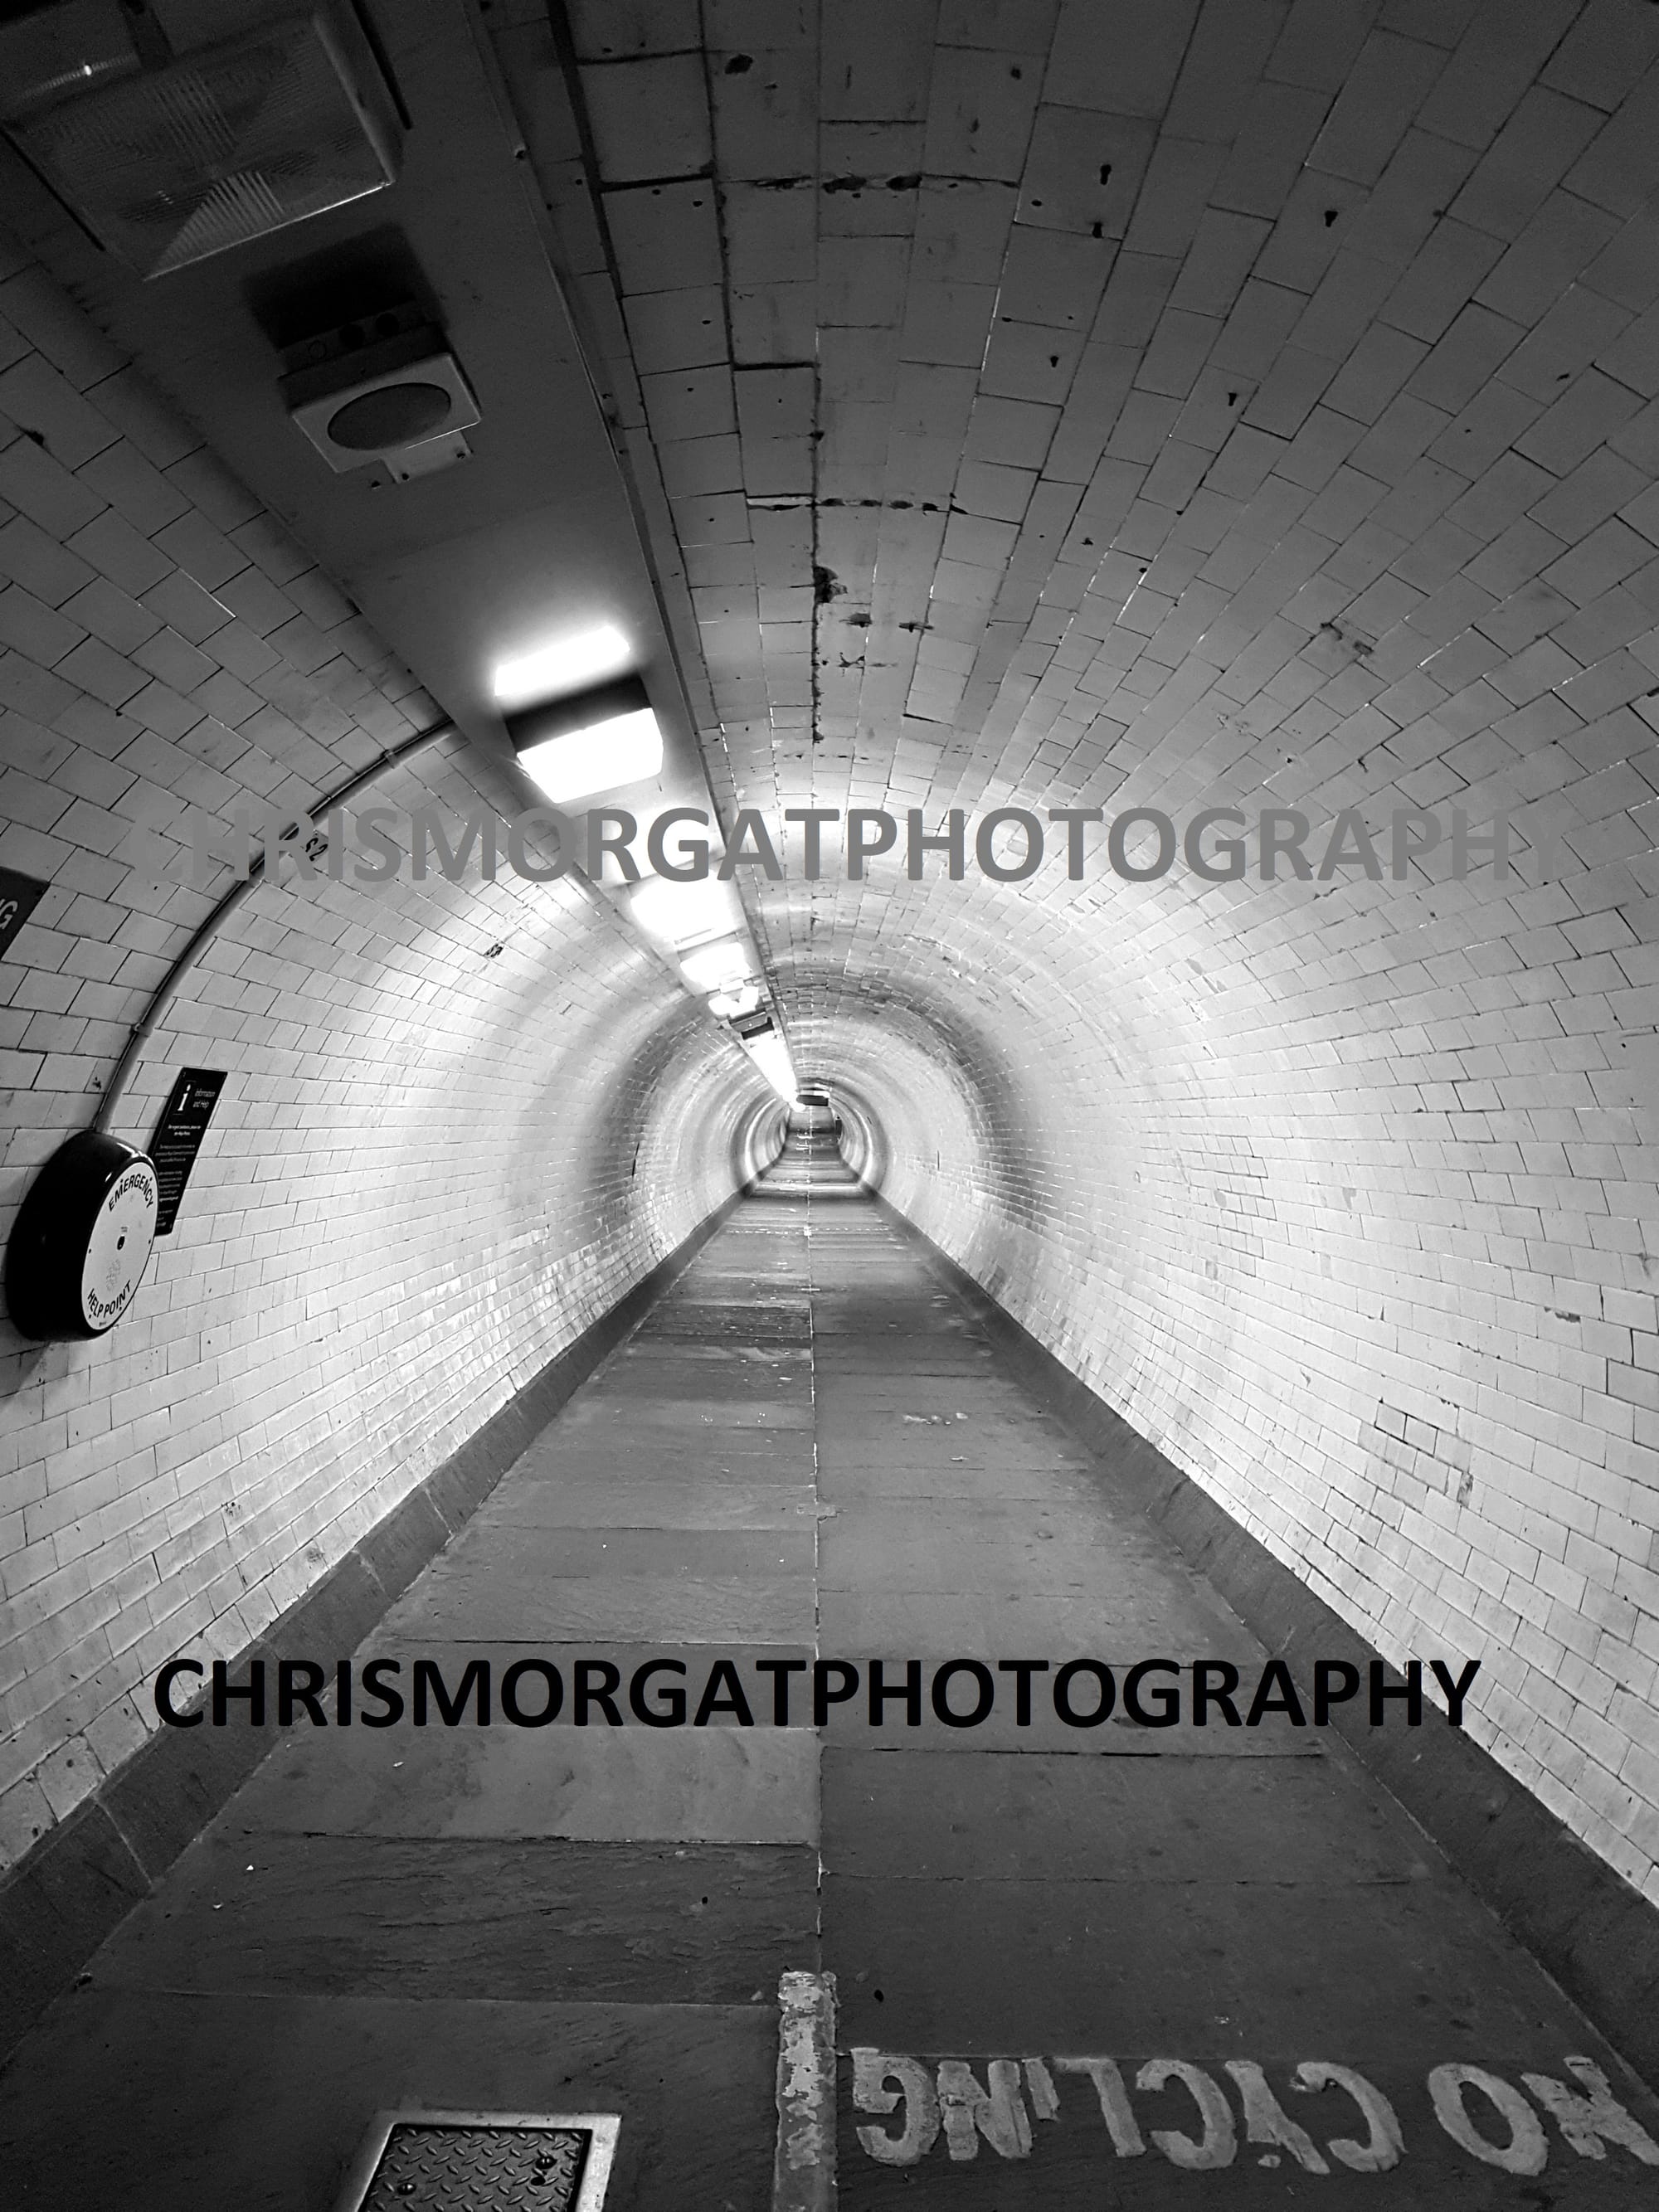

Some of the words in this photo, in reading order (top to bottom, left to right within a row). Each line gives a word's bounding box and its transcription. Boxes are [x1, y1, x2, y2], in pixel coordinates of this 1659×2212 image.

[109, 1173, 153, 1212] EMERGENCY
[87, 1288, 105, 1318] HELP
[104, 1280, 131, 1319] POINT
[850, 2048, 1407, 2174] CYCLING
[1426, 2054, 1659, 2176] NO
